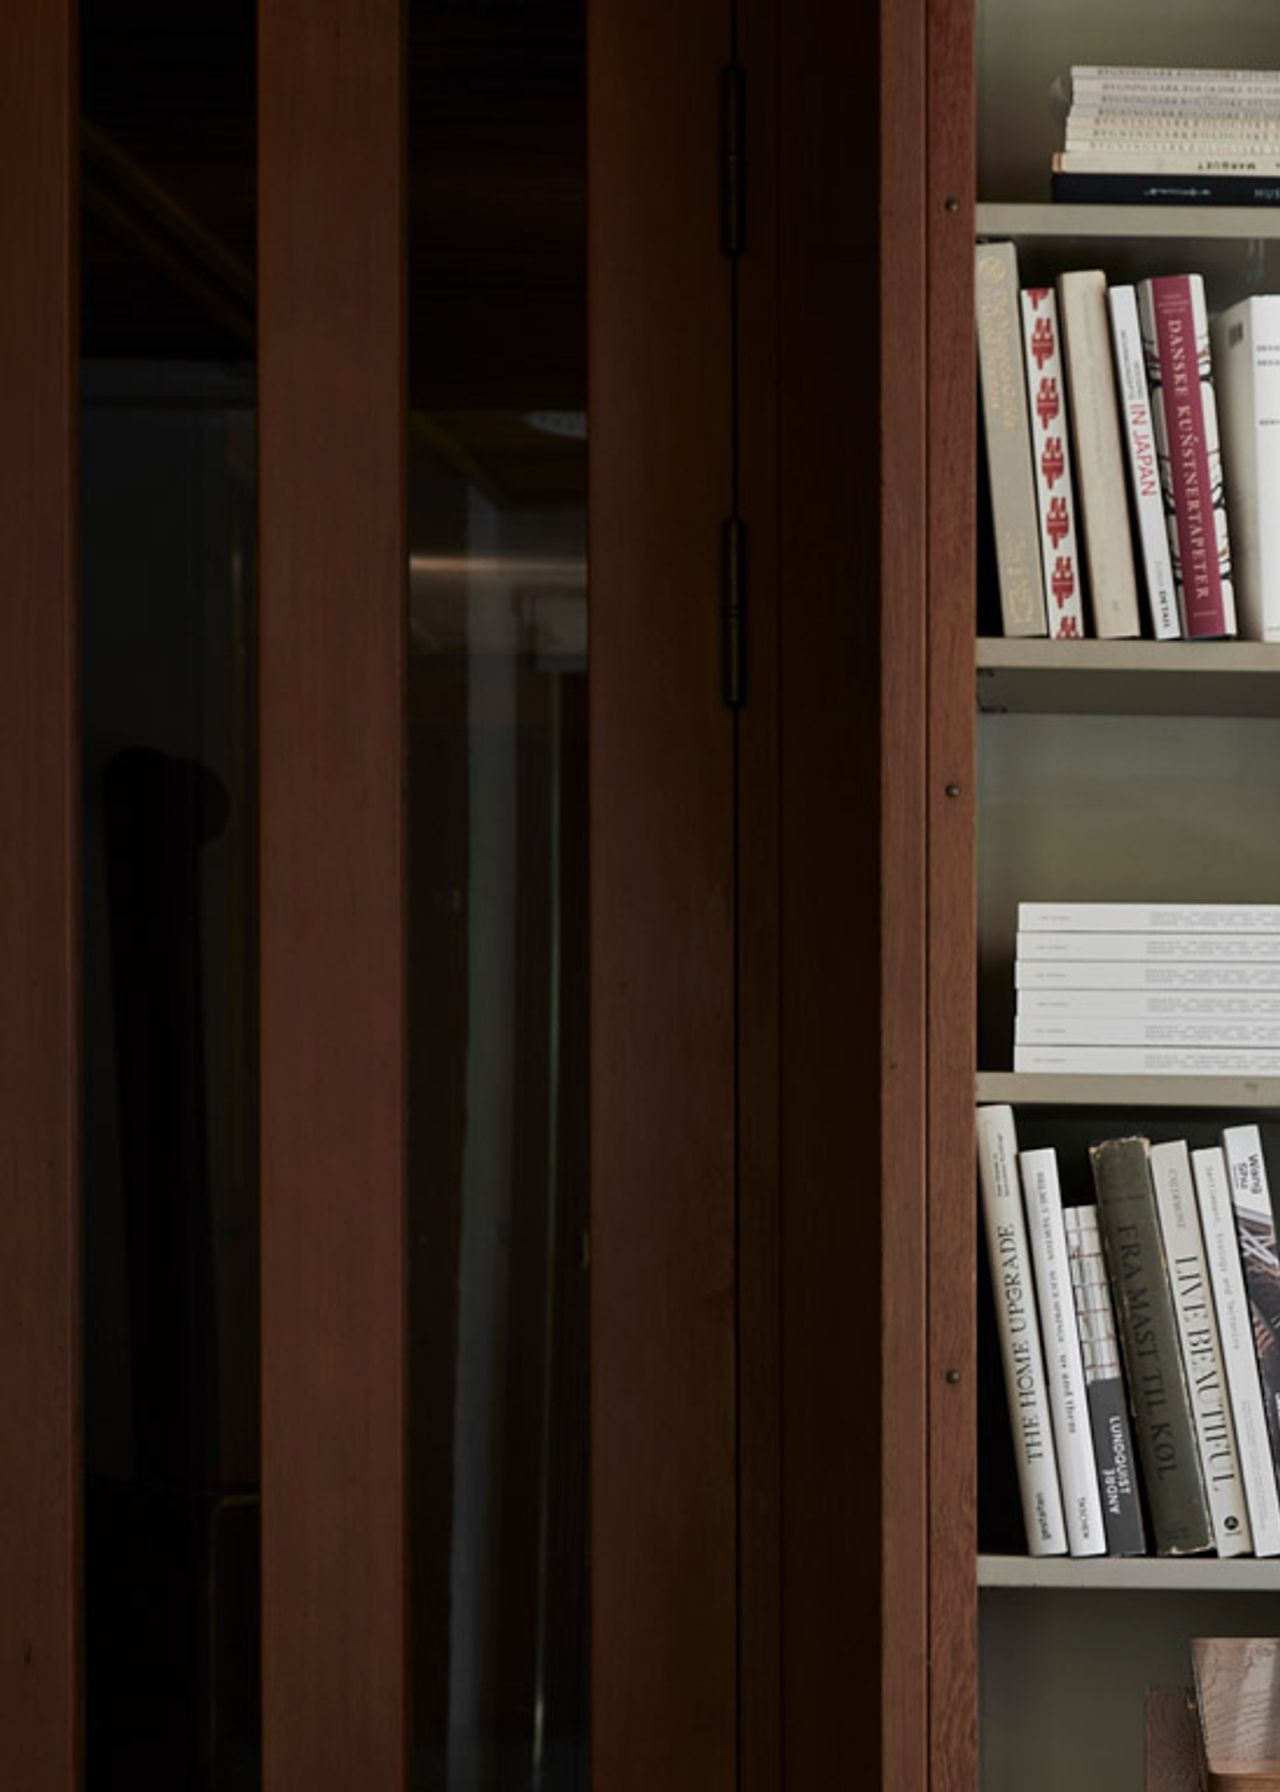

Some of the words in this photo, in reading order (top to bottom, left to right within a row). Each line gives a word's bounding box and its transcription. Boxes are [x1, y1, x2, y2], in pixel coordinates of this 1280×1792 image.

[1167, 318, 1189, 398] DANSKE
[1129, 403, 1146, 425] IN
[1132, 429, 1156, 497] JAPAN
[1000, 1223, 1027, 1333] UPGRADE
[1117, 1224, 1143, 1289] FRA
[1175, 1254, 1206, 1323] LIVE
[1129, 1288, 1159, 1363] MAST
[1014, 1340, 1038, 1407] HOME
[1140, 1365, 1165, 1416] TIL
[1021, 1411, 1043, 1465] THE
[1187, 1327, 1236, 1492] BEAUTIFUL
[1150, 1424, 1178, 1480] KØL
